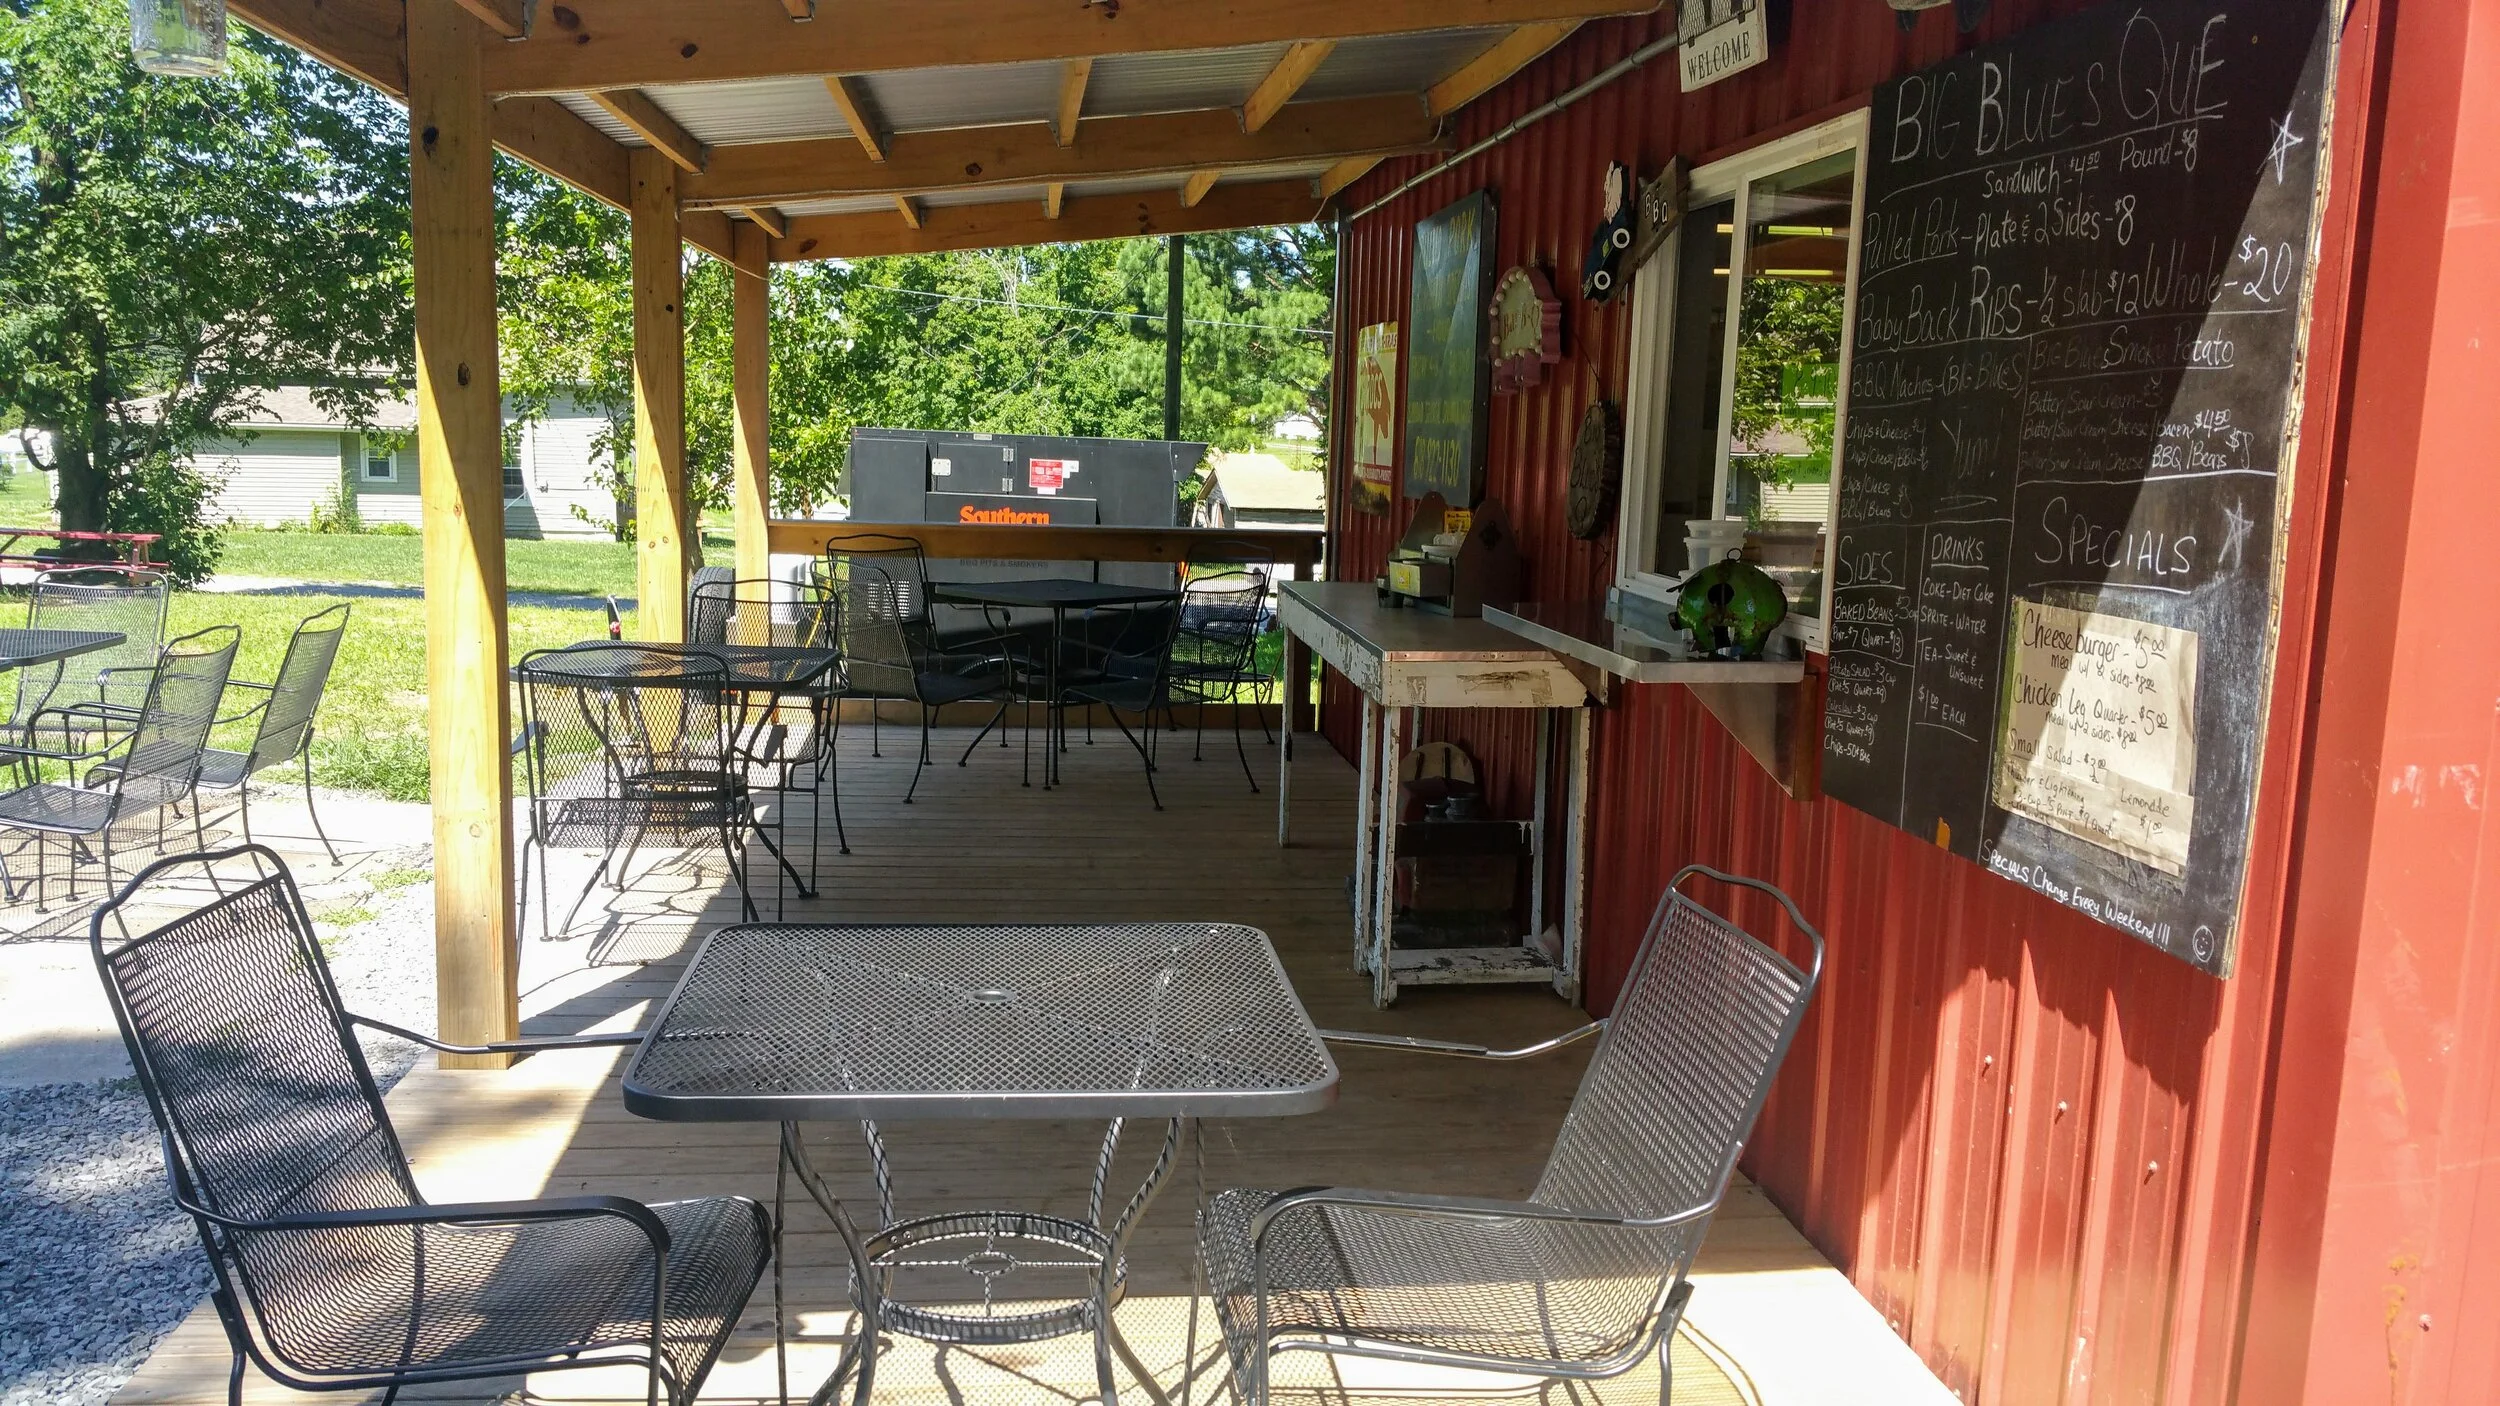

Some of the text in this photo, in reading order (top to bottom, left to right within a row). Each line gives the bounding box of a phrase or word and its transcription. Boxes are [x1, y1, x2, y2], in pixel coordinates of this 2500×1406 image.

[1687, 31, 1751, 83] WELCOME
[1891, 72, 1961, 163] BIG
[2119, 8, 2228, 128] QUE
[1645, 193, 1668, 223] BBQ
[1866, 203, 1916, 273] Pulled
[2034, 201, 2050, 246] 2
[1858, 293, 1903, 353] Baby
[1903, 281, 1960, 344] Back
[2174, 320, 2235, 367] Potato
[1852, 360, 1886, 399] BBQ
[2152, 444, 2182, 471] BBQ
[960, 504, 1050, 526] Southern
[1931, 533, 1984, 561] DRINKS
[2035, 496, 2197, 575] SPECIALS
[1835, 535, 1893, 586] SIDES
[1834, 596, 1865, 620] BAKED
[1974, 583, 1994, 604] Coke
[2051, 653, 2072, 671] meal
[1942, 704, 1966, 726] EACH
[2013, 673, 2062, 708] Chicken
[2069, 688, 2085, 728] Leg
[2094, 699, 2128, 726] Quarter
[2009, 728, 2039, 757] Small
[2047, 746, 2073, 766] Salad
[2032, 865, 2069, 903] Change
